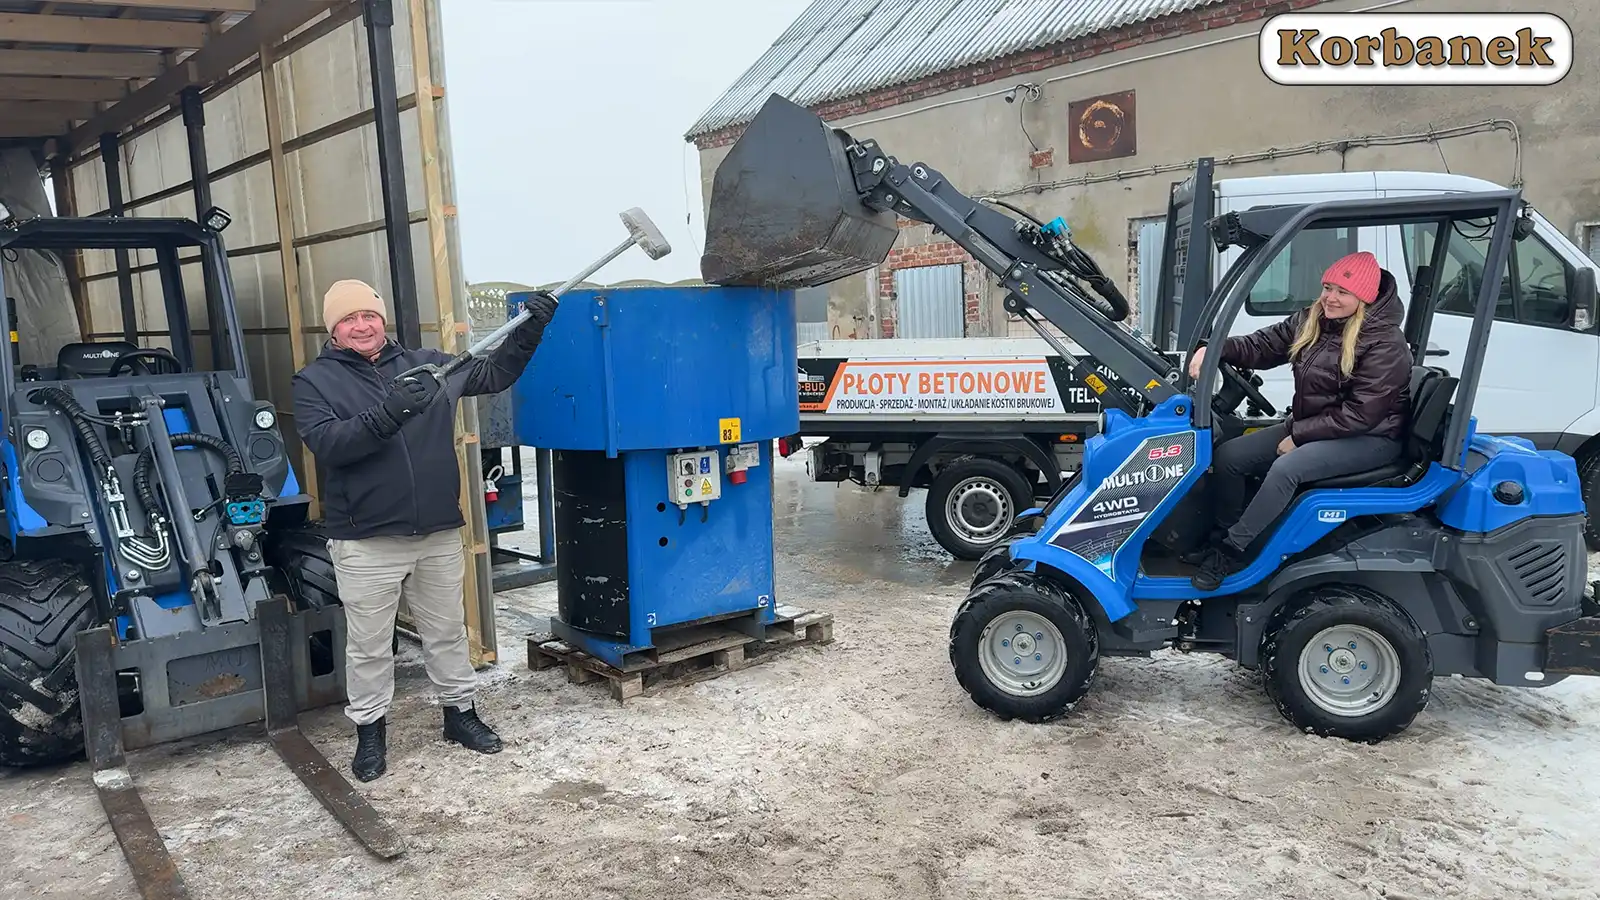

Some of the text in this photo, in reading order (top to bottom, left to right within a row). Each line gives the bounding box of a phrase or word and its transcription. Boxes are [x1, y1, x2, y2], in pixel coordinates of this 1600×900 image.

[843, 371, 1046, 395] PŁOTY BETONOWE
[836, 399, 876, 409] PRODUKCJA
[880, 397, 914, 409] SPRZEDAŻ
[917, 397, 947, 409] MONTAŻ
[951, 399, 990, 409] UKŁADANIE
[991, 398, 1016, 408] KOSTKI
[1017, 398, 1055, 408] BRUKOWEJ
[723, 428, 732, 441] 83
[1148, 444, 1183, 460] 5.3
[1092, 496, 1139, 513] 4WD
[1093, 507, 1140, 520] HYDROSTATIC
